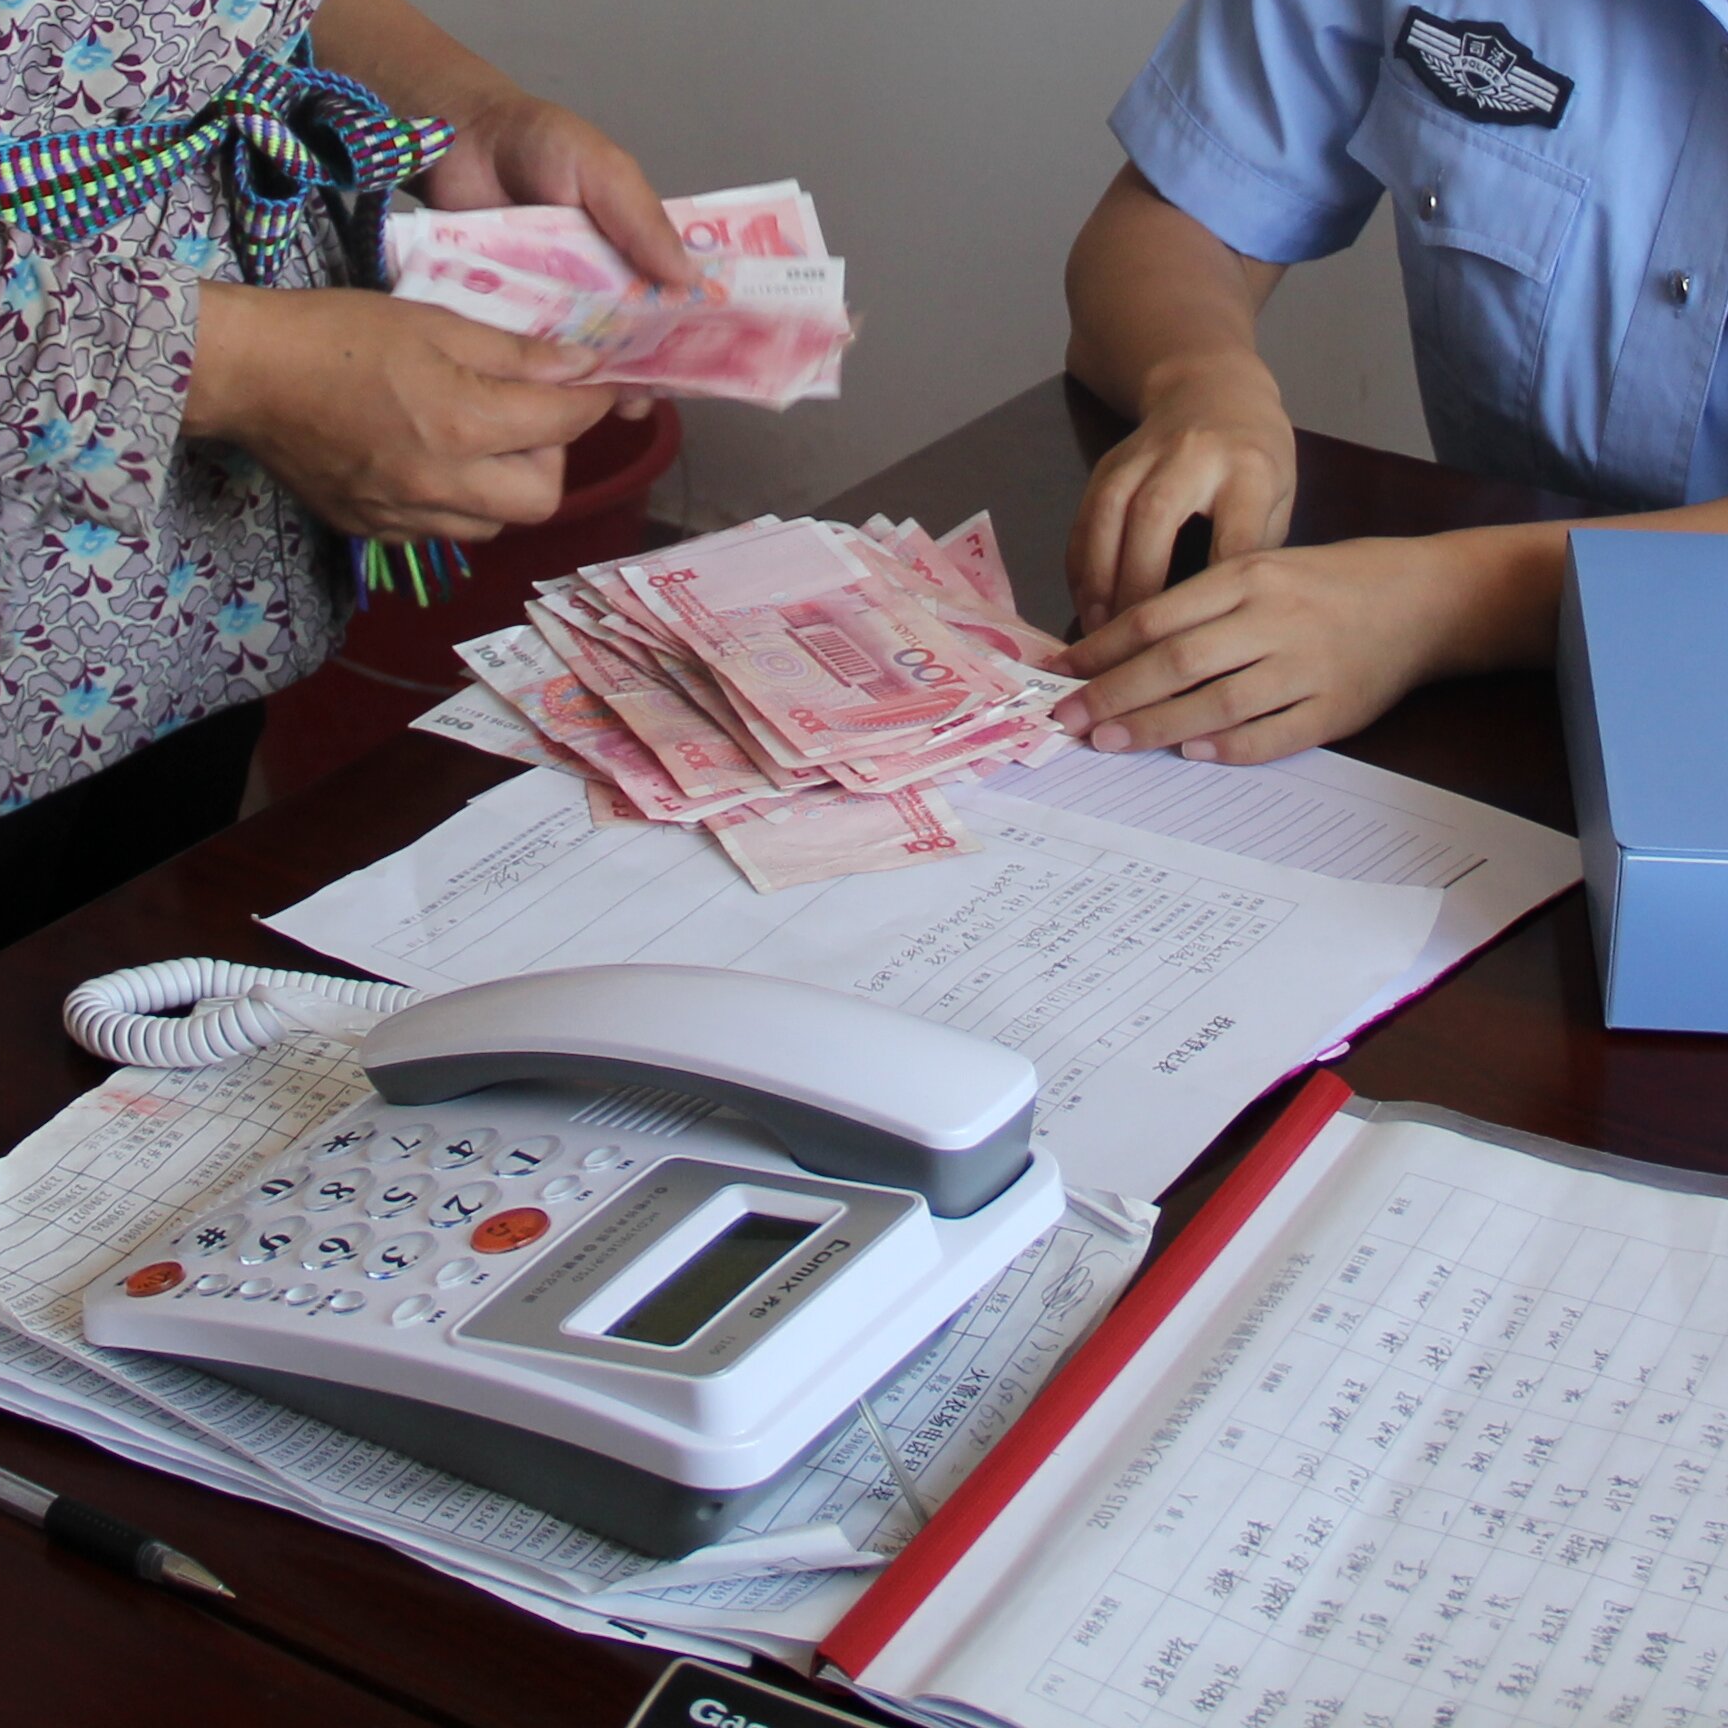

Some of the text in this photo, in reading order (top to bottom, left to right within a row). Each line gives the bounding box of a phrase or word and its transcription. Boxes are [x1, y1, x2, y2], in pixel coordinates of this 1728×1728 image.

[1461, 58, 1501, 83] POLICE
[649, 568, 700, 588] 100
[474, 643, 506, 670] 100
[892, 648, 968, 690] 100
[1025, 677, 1068, 694] 100
[431, 713, 474, 732] 100
[788, 707, 833, 735] 100
[901, 835, 957, 854] 100
[392, 1135, 422, 1153] 7
[446, 1138, 477, 1160] 4
[509, 1147, 542, 1167] 1
[260, 1178, 294, 1198] 0
[319, 1181, 355, 1200] 8
[382, 1185, 418, 1206] 5
[443, 1194, 483, 1221] 2
[258, 1232, 292, 1253] 9
[319, 1237, 350, 1258] 6
[381, 1244, 418, 1269] 3
[774, 1237, 854, 1296] Comix
[982, 1292, 1012, 1314] 姓名
[1084, 1492, 1131, 1530] 2015
[1068, 1594, 1124, 1646] 纠纷类型
[689, 1697, 769, 1728] Ga
